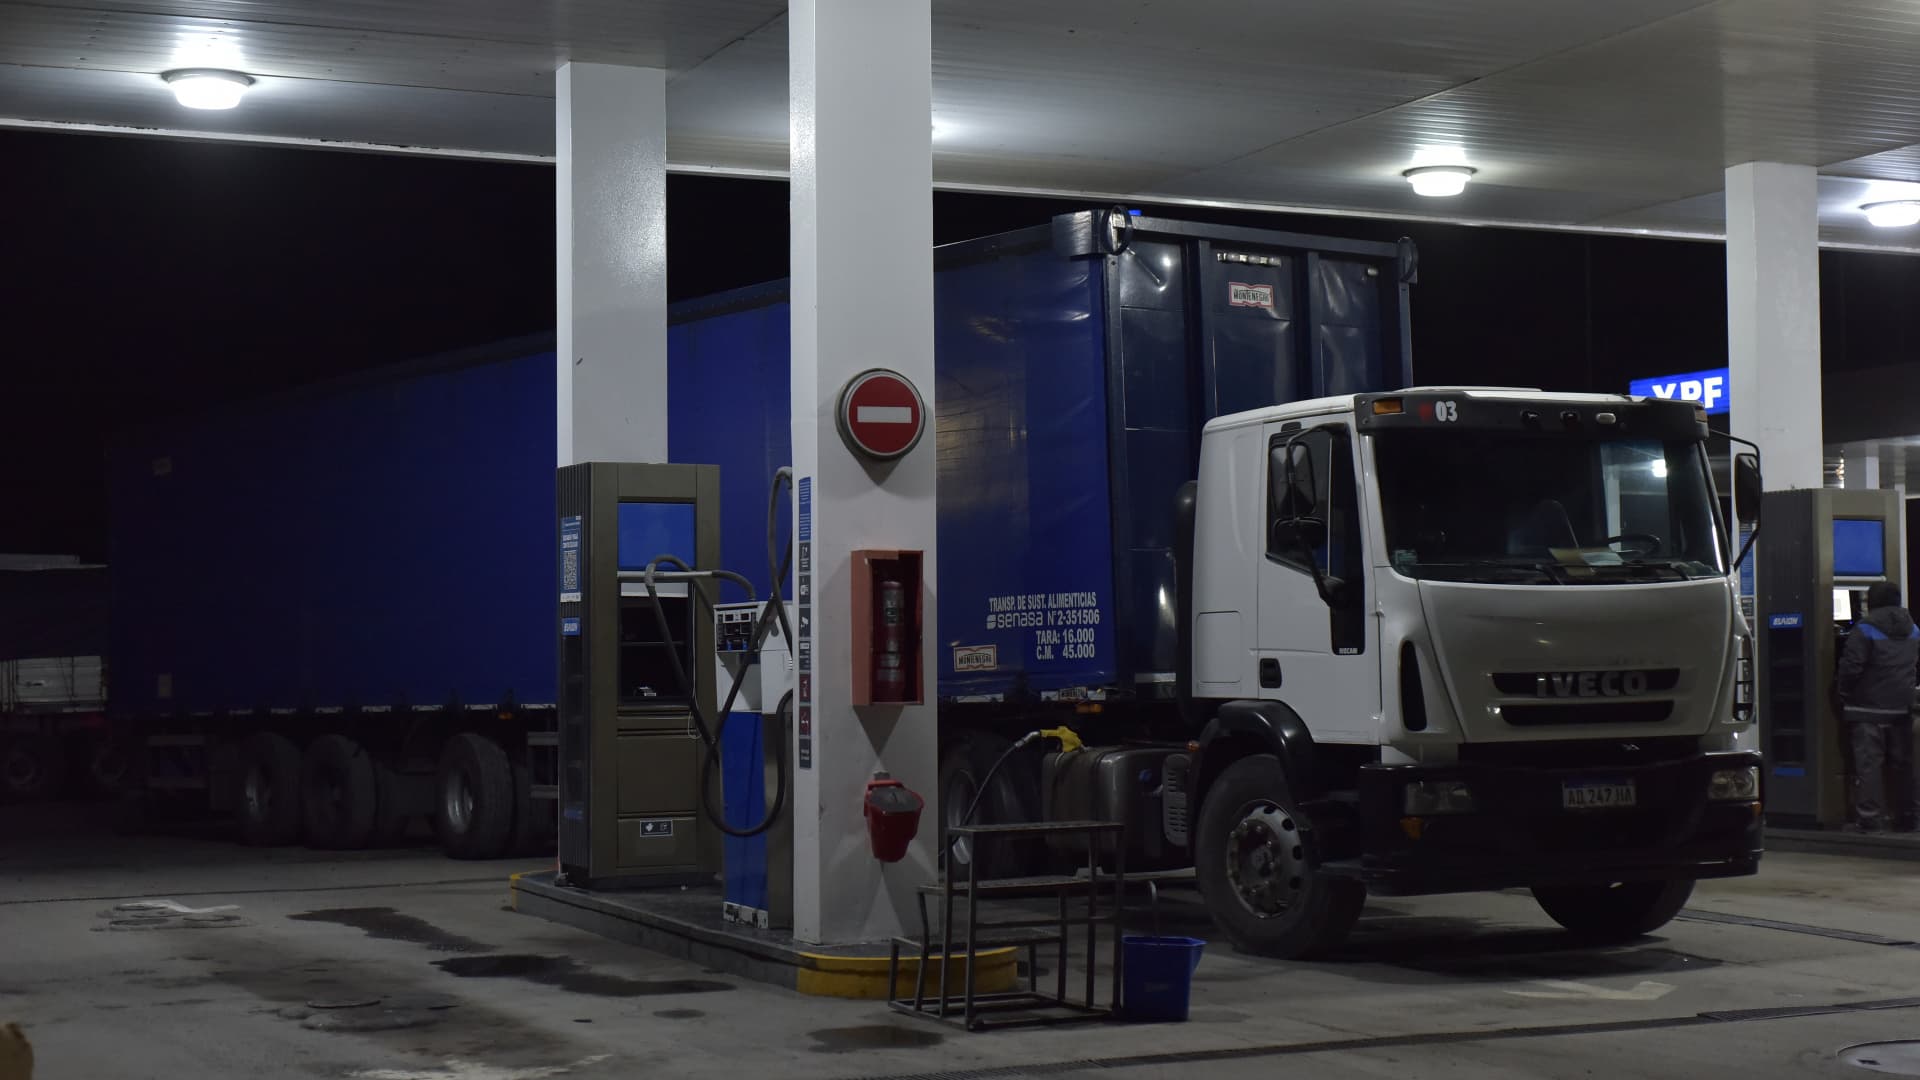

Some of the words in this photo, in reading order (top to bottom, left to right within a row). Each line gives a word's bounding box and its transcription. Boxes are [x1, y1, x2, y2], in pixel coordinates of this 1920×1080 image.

[1435, 400, 1458, 422] 03
[989, 596, 1016, 612] TRANSP.
[1017, 595, 1027, 610] DE
[1027, 593, 1047, 610] SUST.
[1048, 592, 1097, 608] ALIMENTICIAS
[997, 611, 1043, 628] senasa
[1036, 630, 1061, 644] TARA:
[1062, 628, 1095, 644] 16.000
[1036, 646, 1055, 660] C.M.
[1062, 644, 1095, 659] 45.000
[1536, 671, 1648, 697] IVECO
